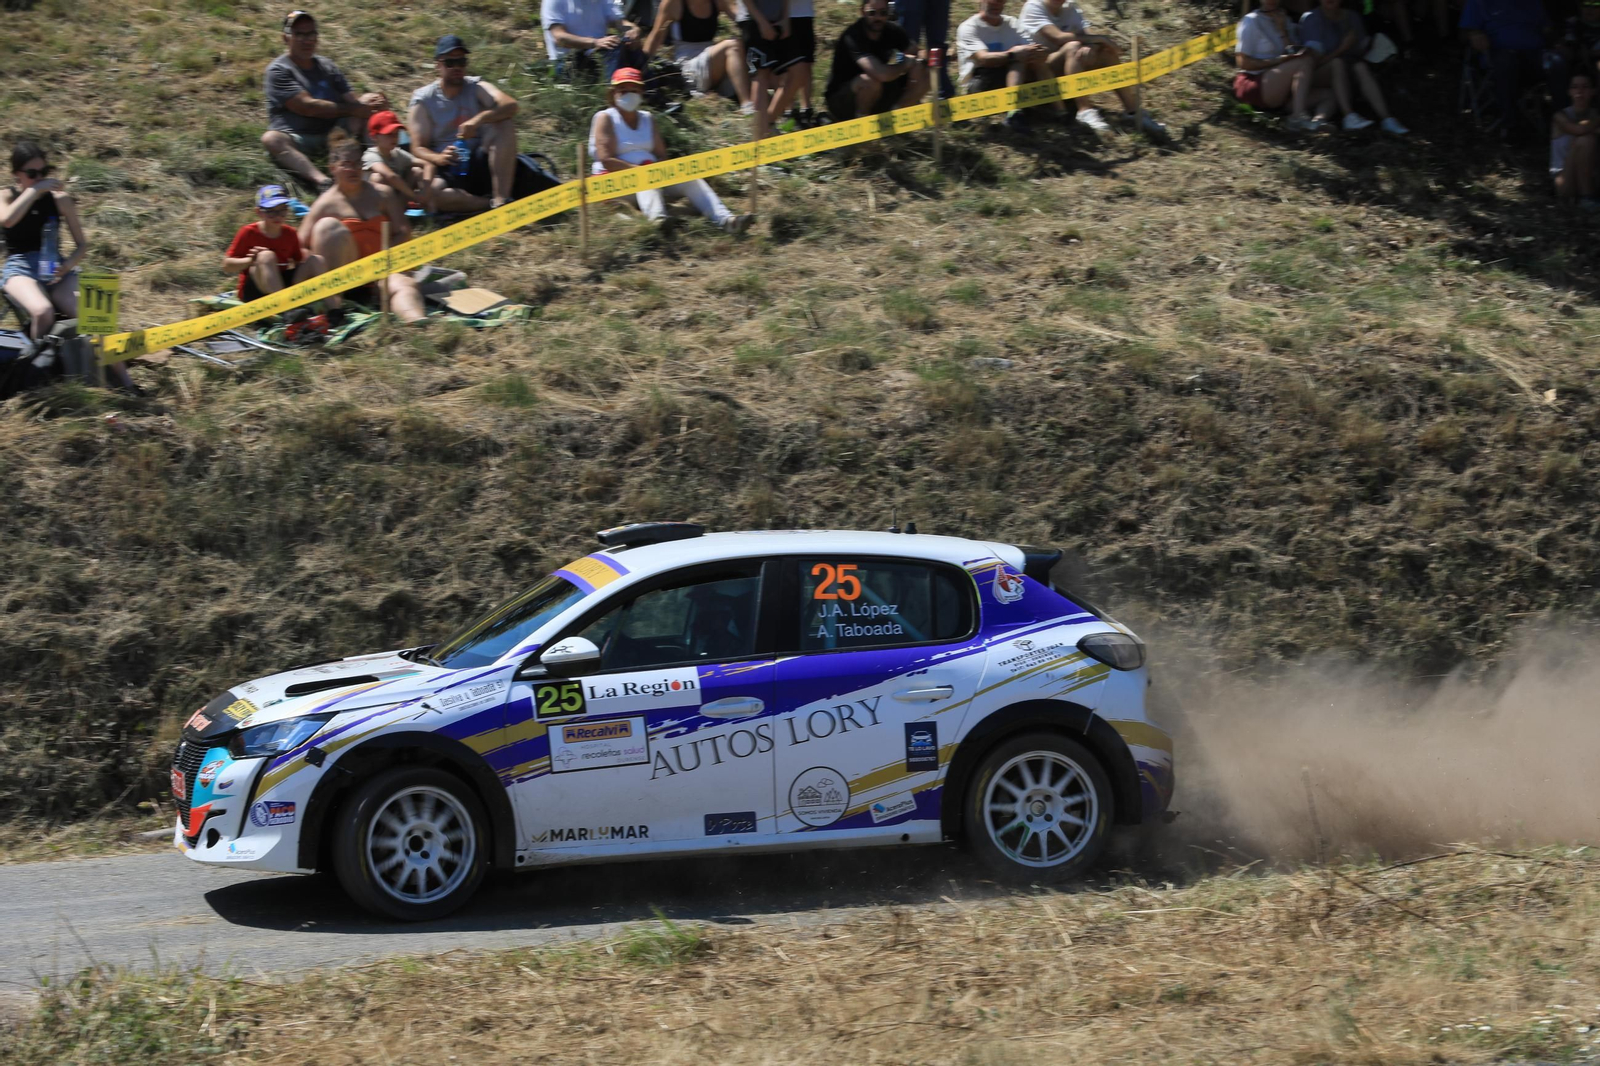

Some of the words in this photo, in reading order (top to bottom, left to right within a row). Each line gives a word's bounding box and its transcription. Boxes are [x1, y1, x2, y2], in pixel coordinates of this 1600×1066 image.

[811, 563, 862, 600] 25
[817, 604, 848, 618] J.A.
[850, 603, 899, 619] López
[817, 625, 833, 638] A.
[834, 621, 904, 638] Taboada
[537, 683, 583, 715] 25
[588, 686, 618, 699] La
[575, 724, 619, 740] Recalvi
[649, 723, 775, 780] AUTOS
[783, 695, 883, 746] LORY
[581, 747, 621, 760] recoletas
[623, 746, 646, 756] salud
[817, 808, 842, 816] VIVIENDA
